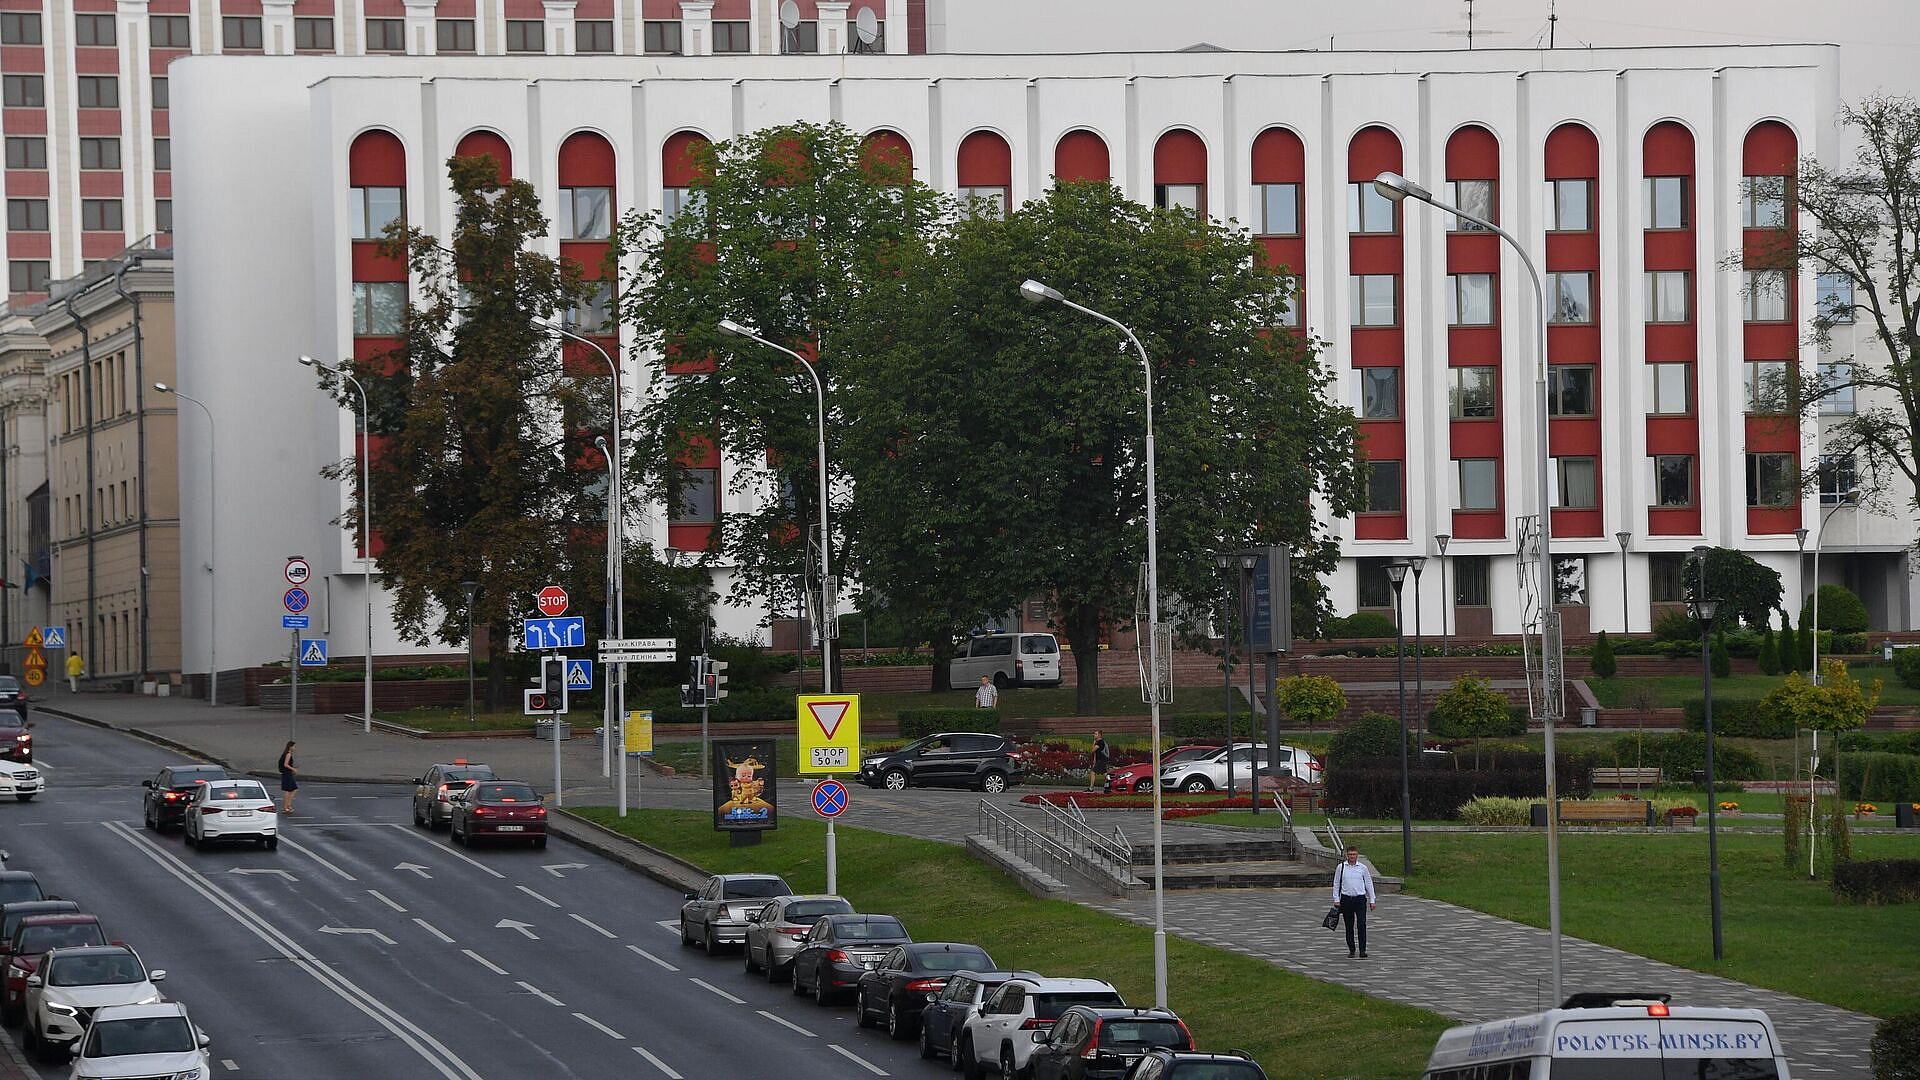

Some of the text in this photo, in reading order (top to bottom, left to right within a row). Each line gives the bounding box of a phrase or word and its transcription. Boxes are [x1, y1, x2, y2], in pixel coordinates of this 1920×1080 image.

[540, 596, 566, 607] STOP
[814, 748, 844, 757] STOP
[818, 757, 831, 766] 50
[1557, 1033, 1764, 1051] POLOTSK-MINSK.BY
